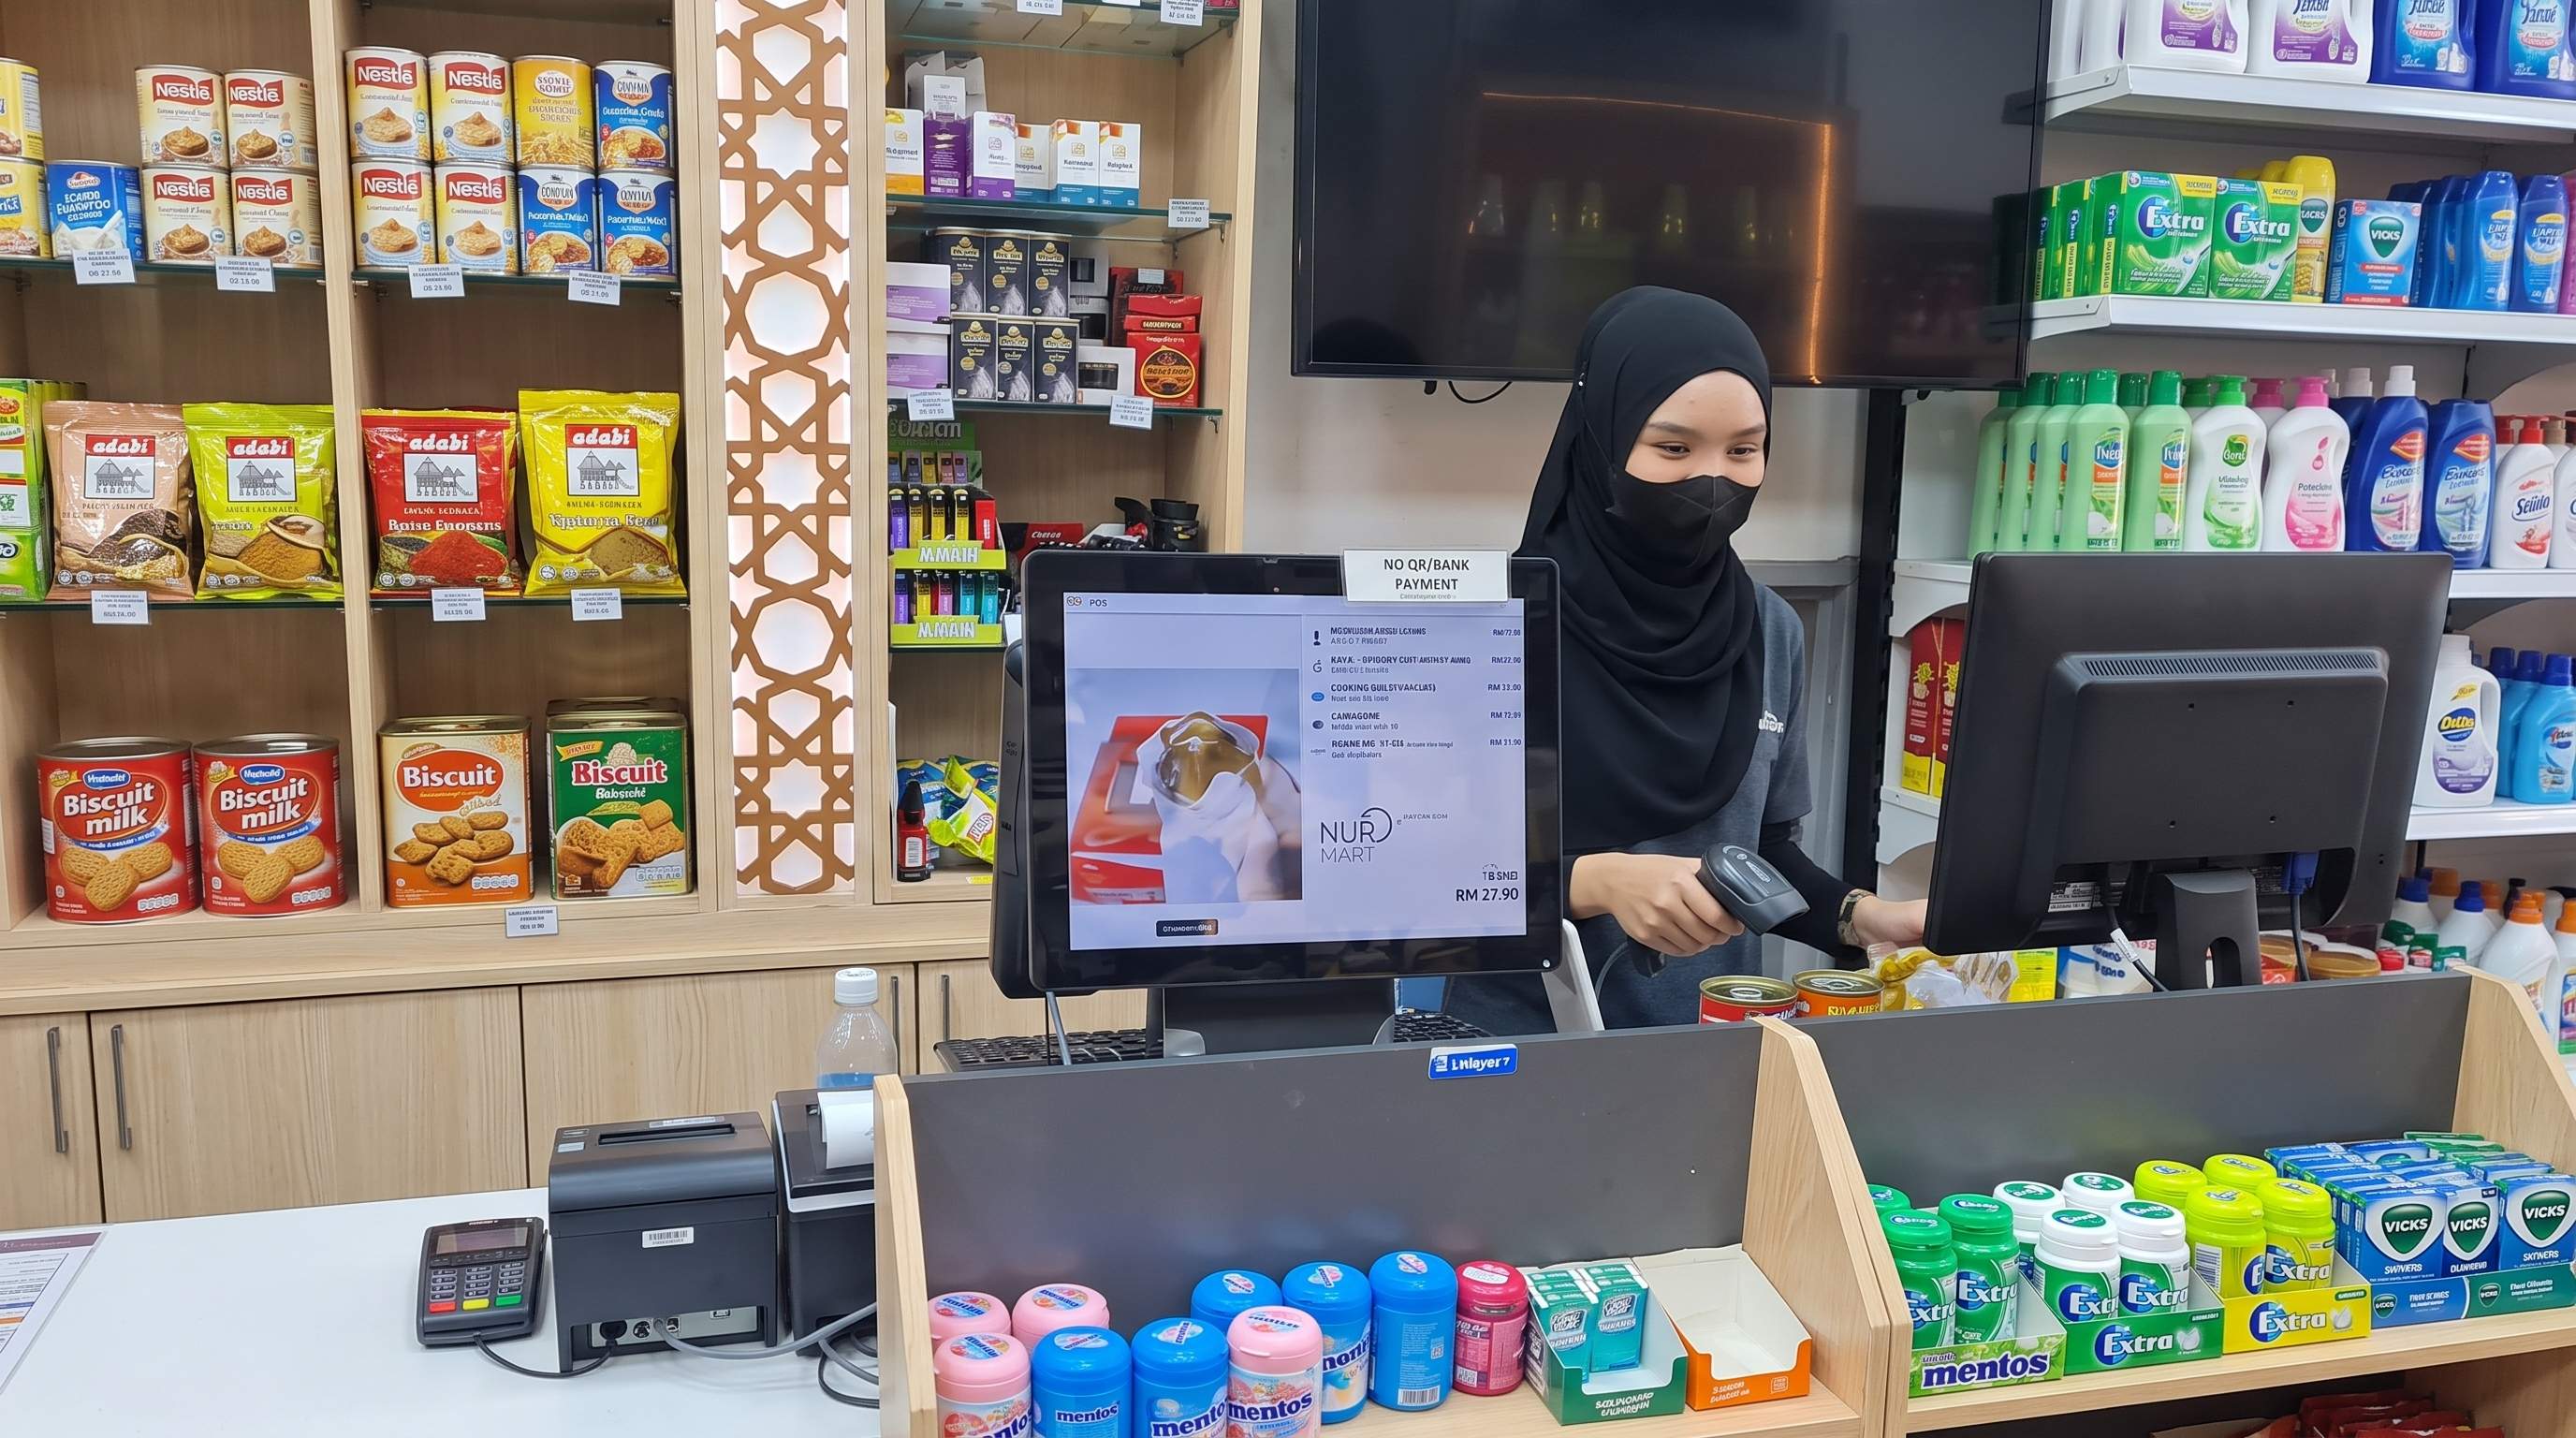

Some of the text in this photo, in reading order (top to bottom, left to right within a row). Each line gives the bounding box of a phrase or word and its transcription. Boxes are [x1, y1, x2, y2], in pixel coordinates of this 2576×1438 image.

[2146, 205, 2204, 230] Extra
[2232, 212, 2291, 237] Extra
[2371, 229, 2401, 241] VICKS
[93, 437, 148, 455] adabi
[409, 433, 470, 452] adabi
[573, 428, 630, 446] adabi
[233, 441, 288, 456] adabi
[1383, 557, 1471, 573] NO QR/BANK
[1395, 578, 1459, 591] PAYMENT
[1090, 598, 1108, 608] POS
[1331, 683, 1369, 692] COOKING
[403, 764, 497, 788] Biscuit
[571, 756, 668, 786] Biscuit
[63, 781, 155, 816] Biscuit
[219, 778, 309, 812] Biscuit
[86, 807, 150, 836] milk
[241, 800, 302, 830] milk
[1320, 846, 1376, 863] MART
[1456, 887, 1519, 902] RM 27.90
[2524, 1204, 2566, 1219] VICKS
[2384, 1217, 2429, 1233] VICKS
[2450, 1216, 2488, 1232] VICKS
[2266, 1253, 2330, 1281] Extra
[2259, 1311, 2326, 1334] Extra
[2103, 1332, 2174, 1357] Extra
[1923, 1352, 2050, 1389] mentos
[1228, 1392, 1313, 1421] mentos
